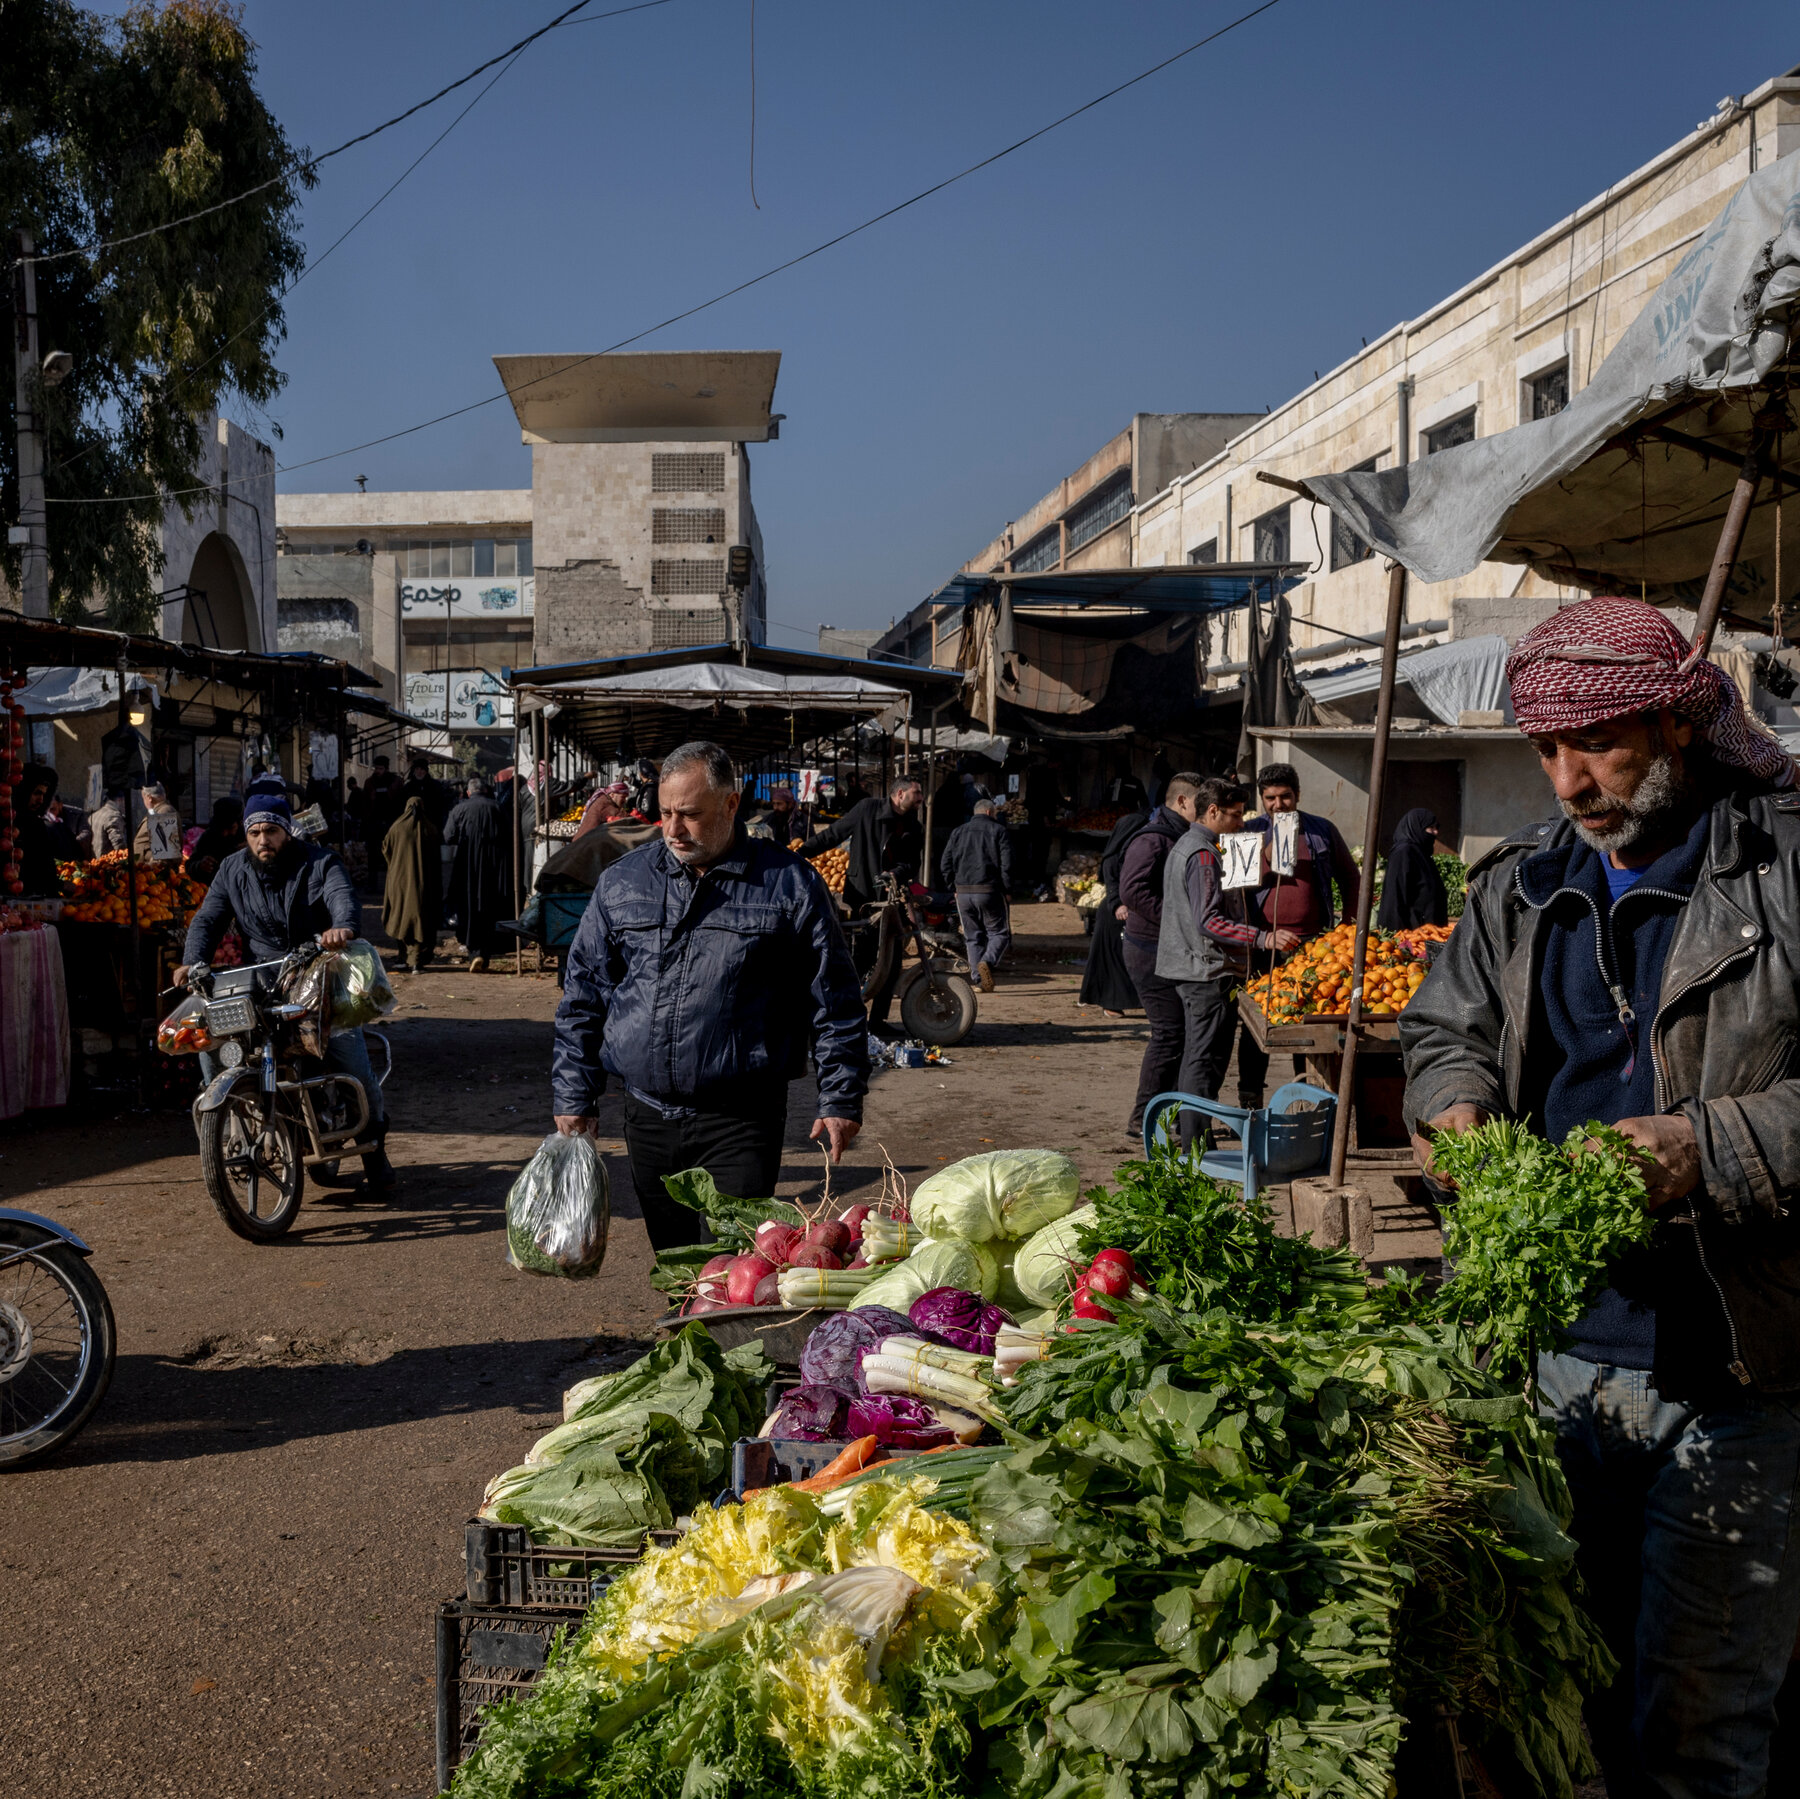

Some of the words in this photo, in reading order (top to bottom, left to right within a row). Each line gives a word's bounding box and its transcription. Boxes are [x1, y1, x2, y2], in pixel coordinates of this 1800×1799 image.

[402, 585, 461, 611] مجمع
[416, 684, 445, 693] IDLIB
[413, 708, 438, 721] إدلب
[441, 709, 467, 721] مجمع
